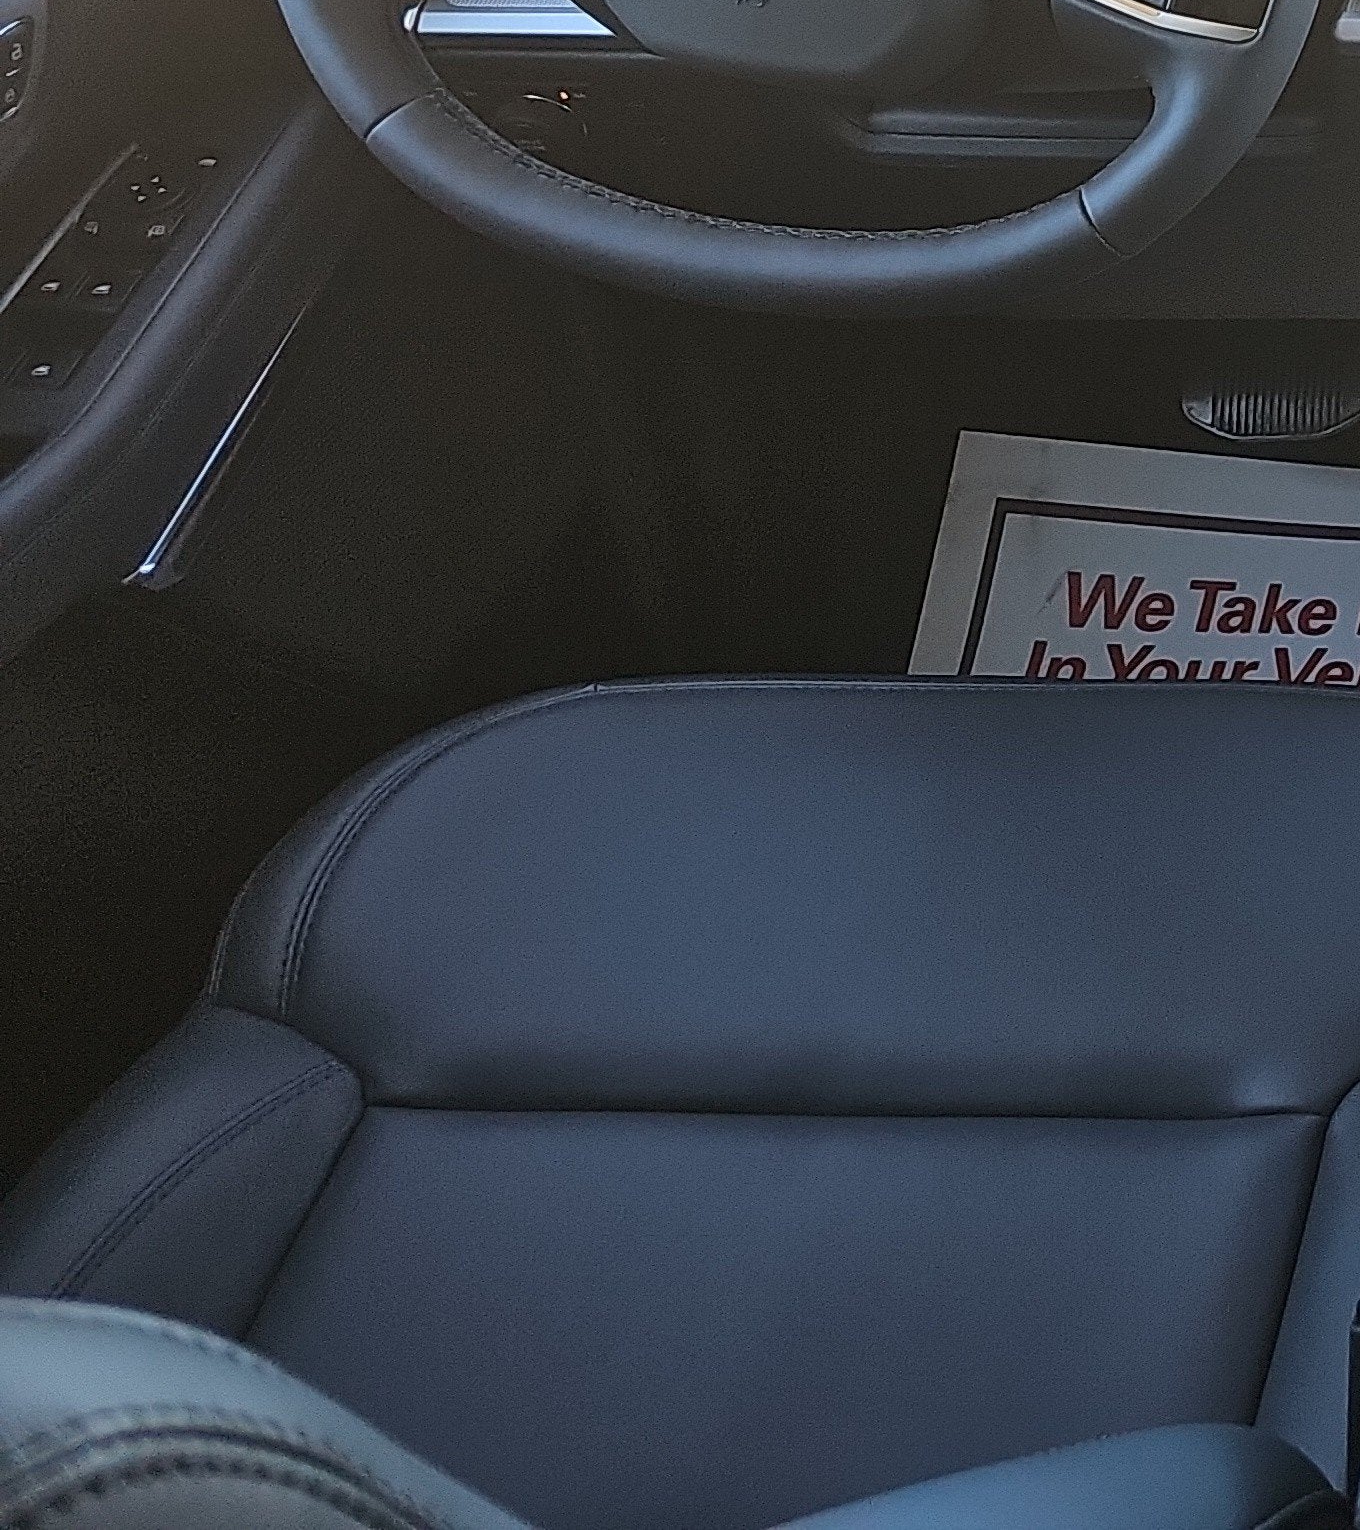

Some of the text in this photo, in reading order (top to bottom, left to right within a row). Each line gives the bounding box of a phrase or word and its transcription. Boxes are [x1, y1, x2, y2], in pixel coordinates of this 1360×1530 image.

[1068, 570, 1176, 634] We
[1190, 581, 1338, 637] Take
[1026, 641, 1084, 684] In
[1106, 643, 1260, 684] Your
